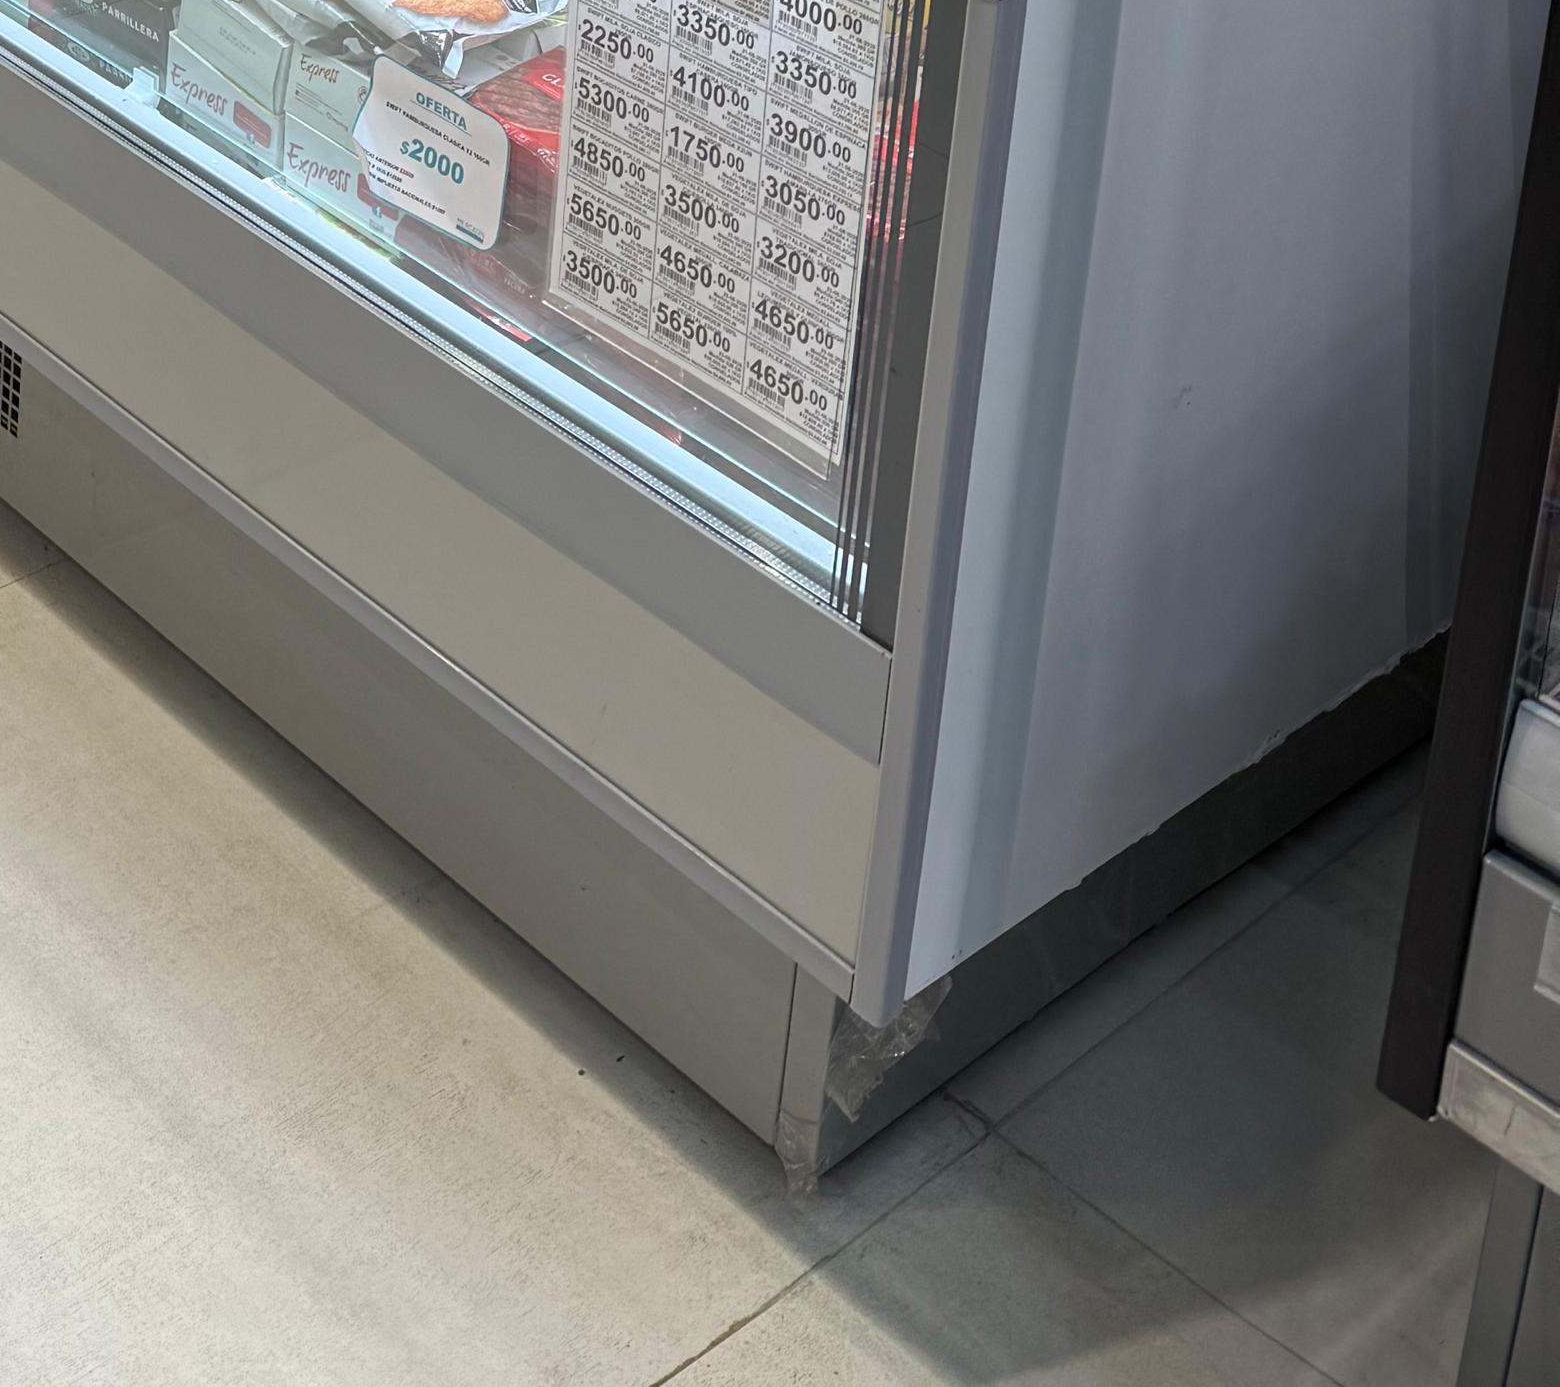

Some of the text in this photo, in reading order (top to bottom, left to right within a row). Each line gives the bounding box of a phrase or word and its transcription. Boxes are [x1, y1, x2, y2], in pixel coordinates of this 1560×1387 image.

[101, 2, 160, 42] PARRILLERA
[170, 62, 228, 116] Express
[301, 54, 339, 83] Express
[415, 92, 467, 131] OFERTA
[287, 142, 352, 193] Express
[400, 139, 464, 184] $2000
